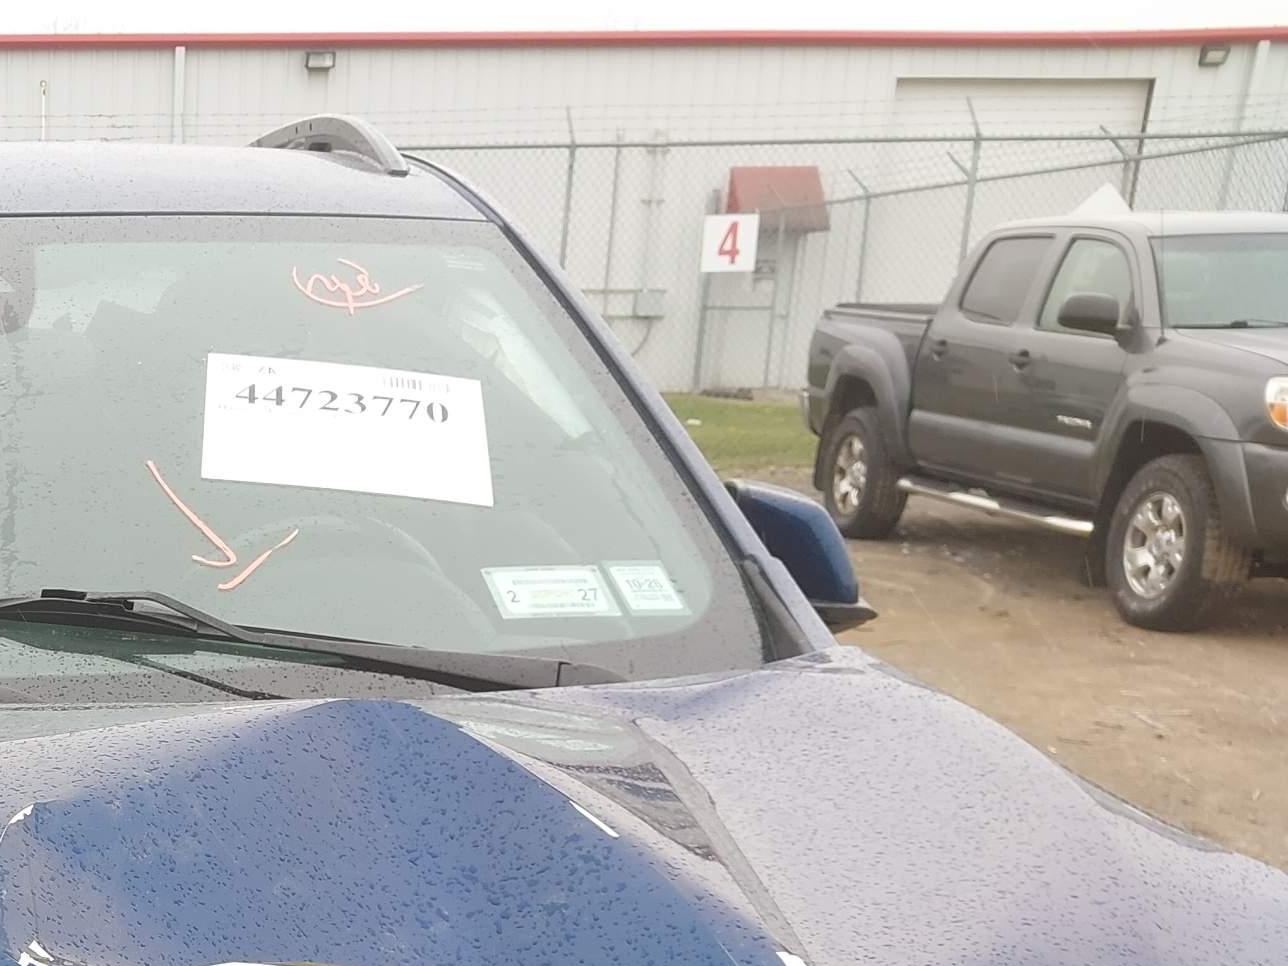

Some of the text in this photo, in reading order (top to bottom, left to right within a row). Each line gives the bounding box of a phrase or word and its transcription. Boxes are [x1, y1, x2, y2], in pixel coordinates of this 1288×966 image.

[718, 221, 740, 265] 4
[234, 383, 450, 423] 44723770
[507, 588, 598, 603] 2 27
